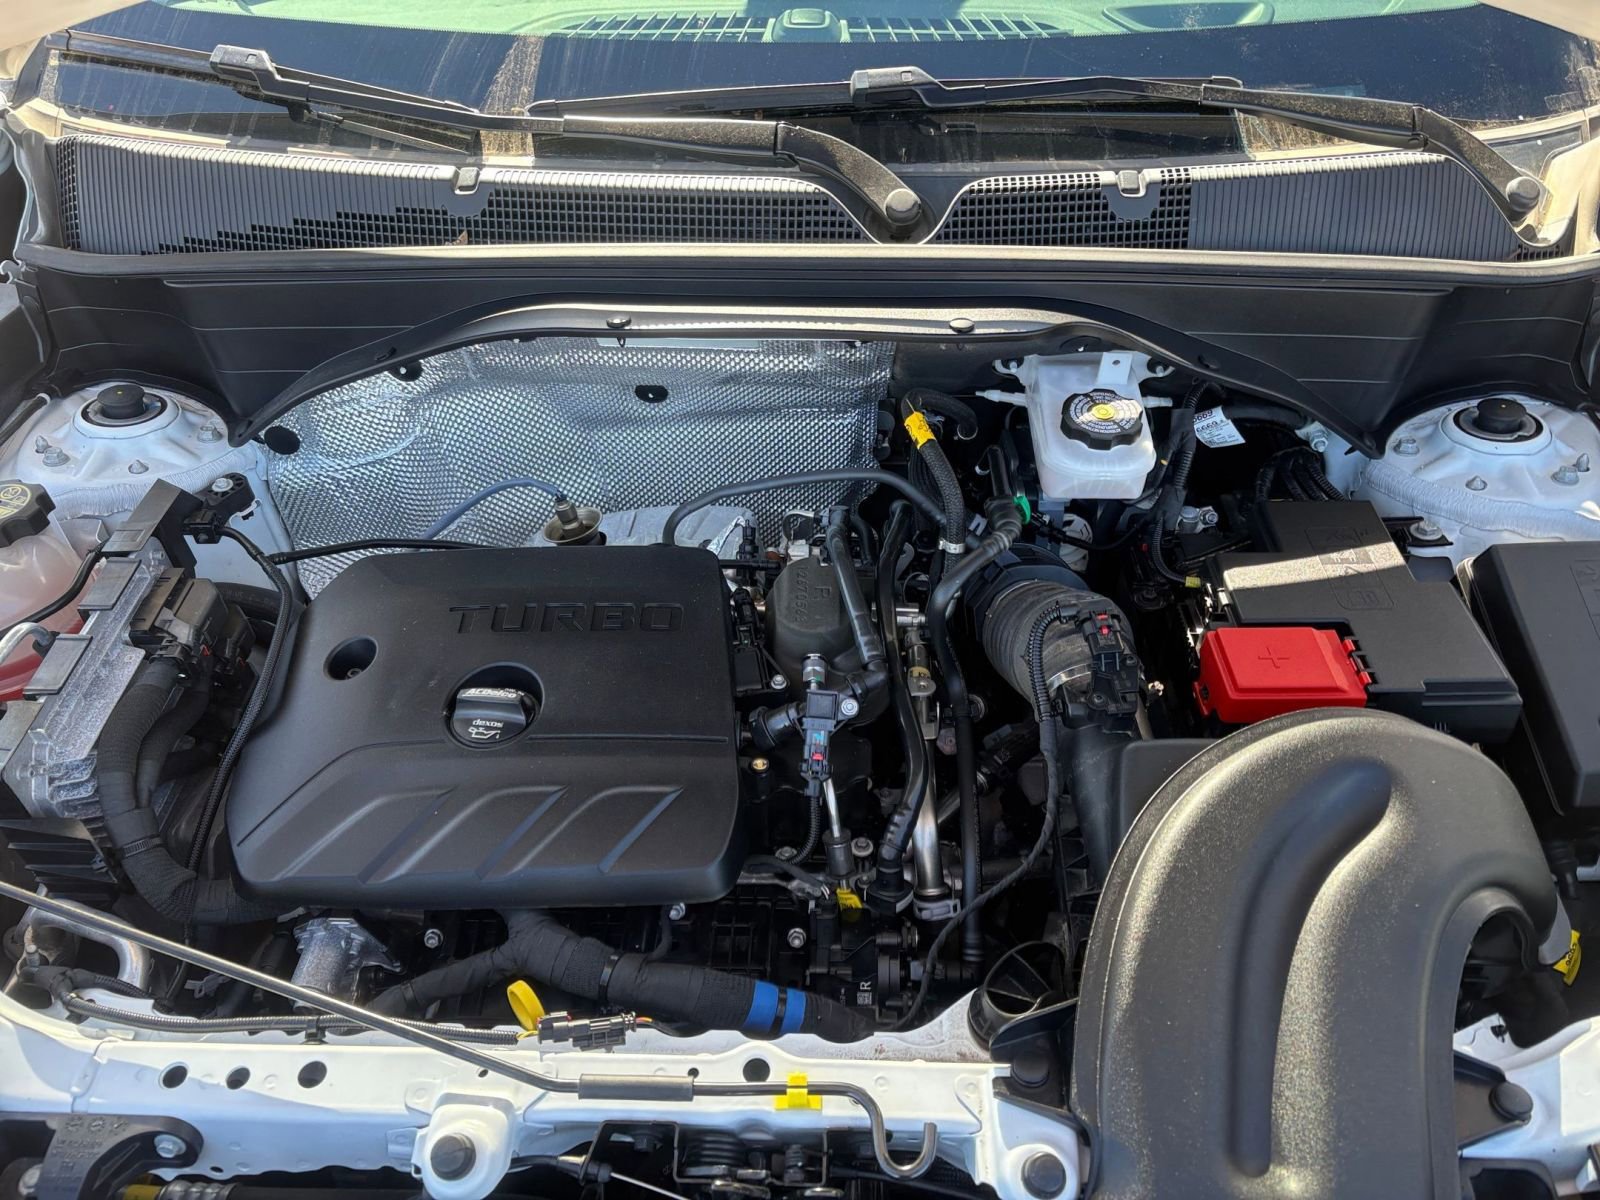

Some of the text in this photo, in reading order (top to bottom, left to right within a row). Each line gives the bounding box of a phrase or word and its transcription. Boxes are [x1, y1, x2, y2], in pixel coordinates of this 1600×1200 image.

[450, 602, 684, 634] TURBO
[461, 687, 518, 699] ACDelco
[472, 718, 504, 729] dexos
